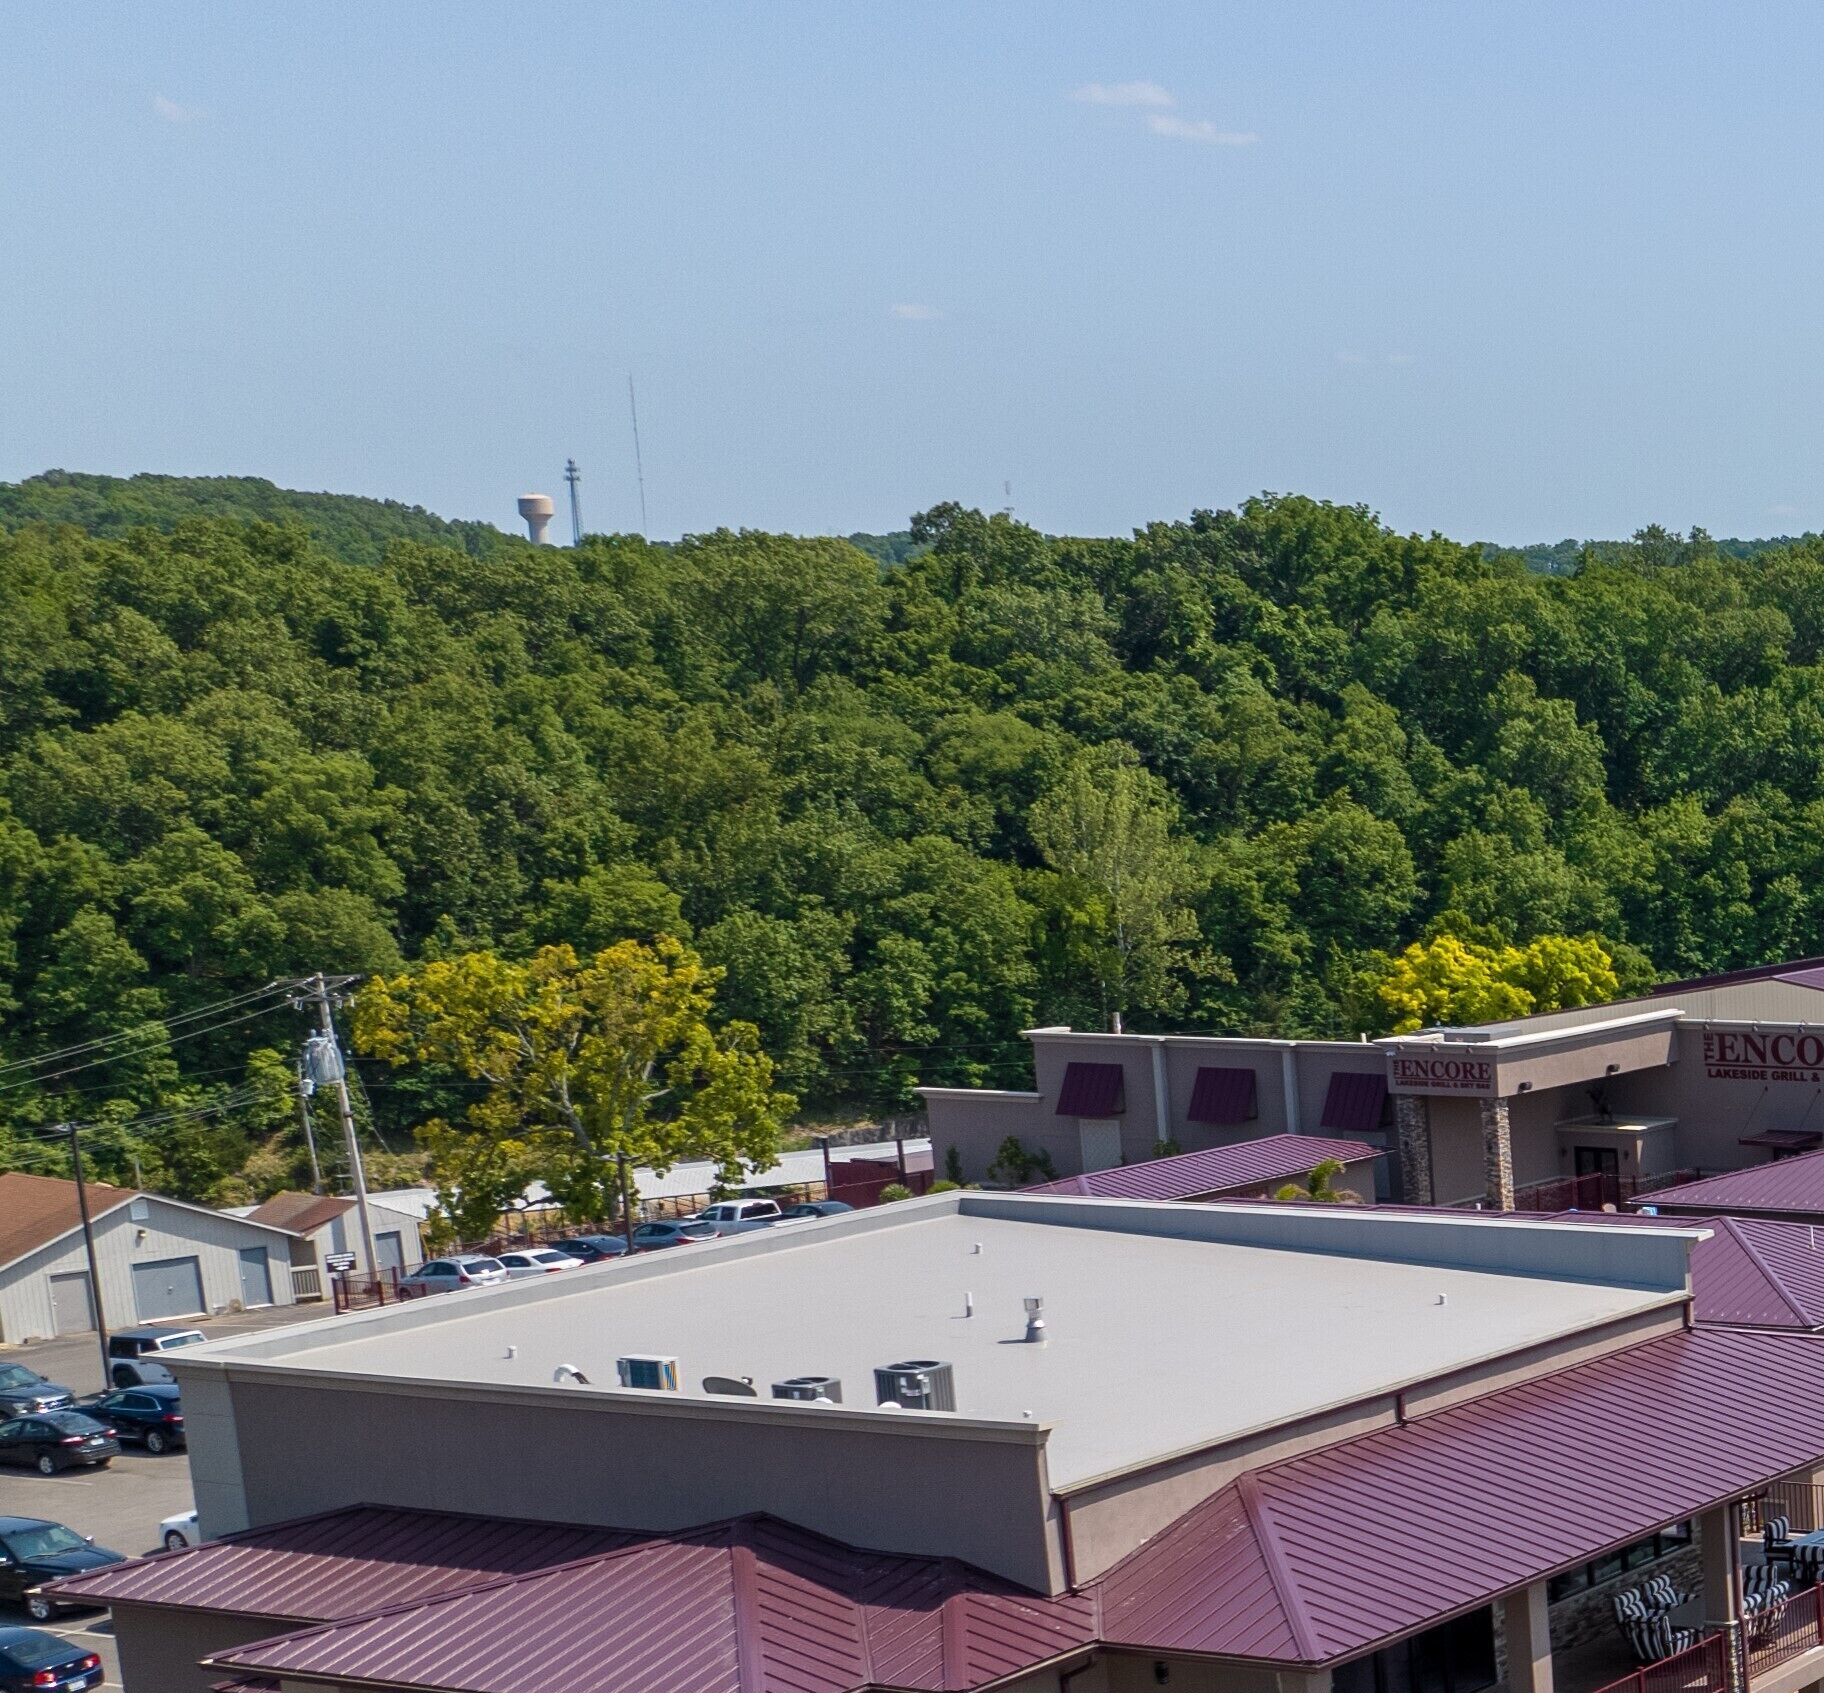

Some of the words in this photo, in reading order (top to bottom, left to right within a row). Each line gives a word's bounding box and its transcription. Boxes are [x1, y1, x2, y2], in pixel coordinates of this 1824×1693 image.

[1704, 1032, 1714, 1061] THE
[1400, 1059, 1492, 1080] ENCORE
[1707, 1068, 1768, 1080] LAKESIDE
[1771, 1071, 1807, 1082] GRILL
[1811, 1072, 1820, 1082] &
